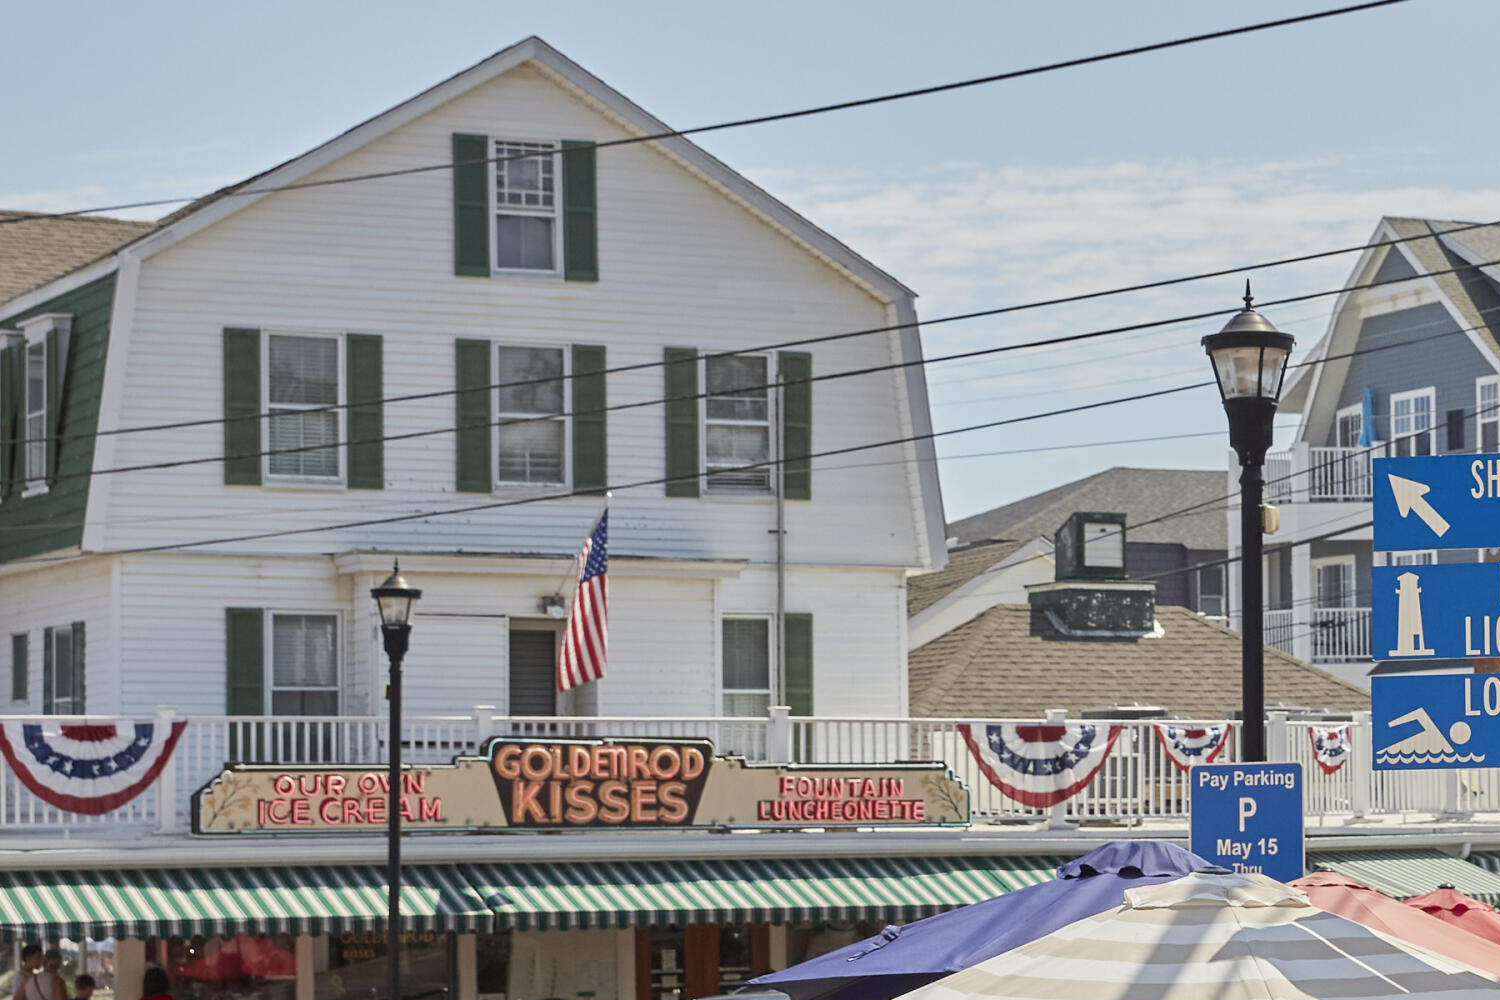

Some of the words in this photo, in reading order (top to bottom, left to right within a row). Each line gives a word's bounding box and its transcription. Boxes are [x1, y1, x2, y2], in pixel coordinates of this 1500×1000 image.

[495, 744, 705, 781] GOLDENROD
[274, 774, 347, 797] OUR
[779, 775, 905, 798] FOUNTAIN
[1199, 771, 1229, 791] Pay
[1233, 770, 1295, 789] Parking
[257, 798, 312, 826] ICE
[512, 779, 689, 824] KISSES
[757, 800, 926, 822] LUNCHEONETTE
[1239, 797, 1257, 832] P
[1216, 838, 1253, 860] May
[1257, 838, 1279, 855] 15
